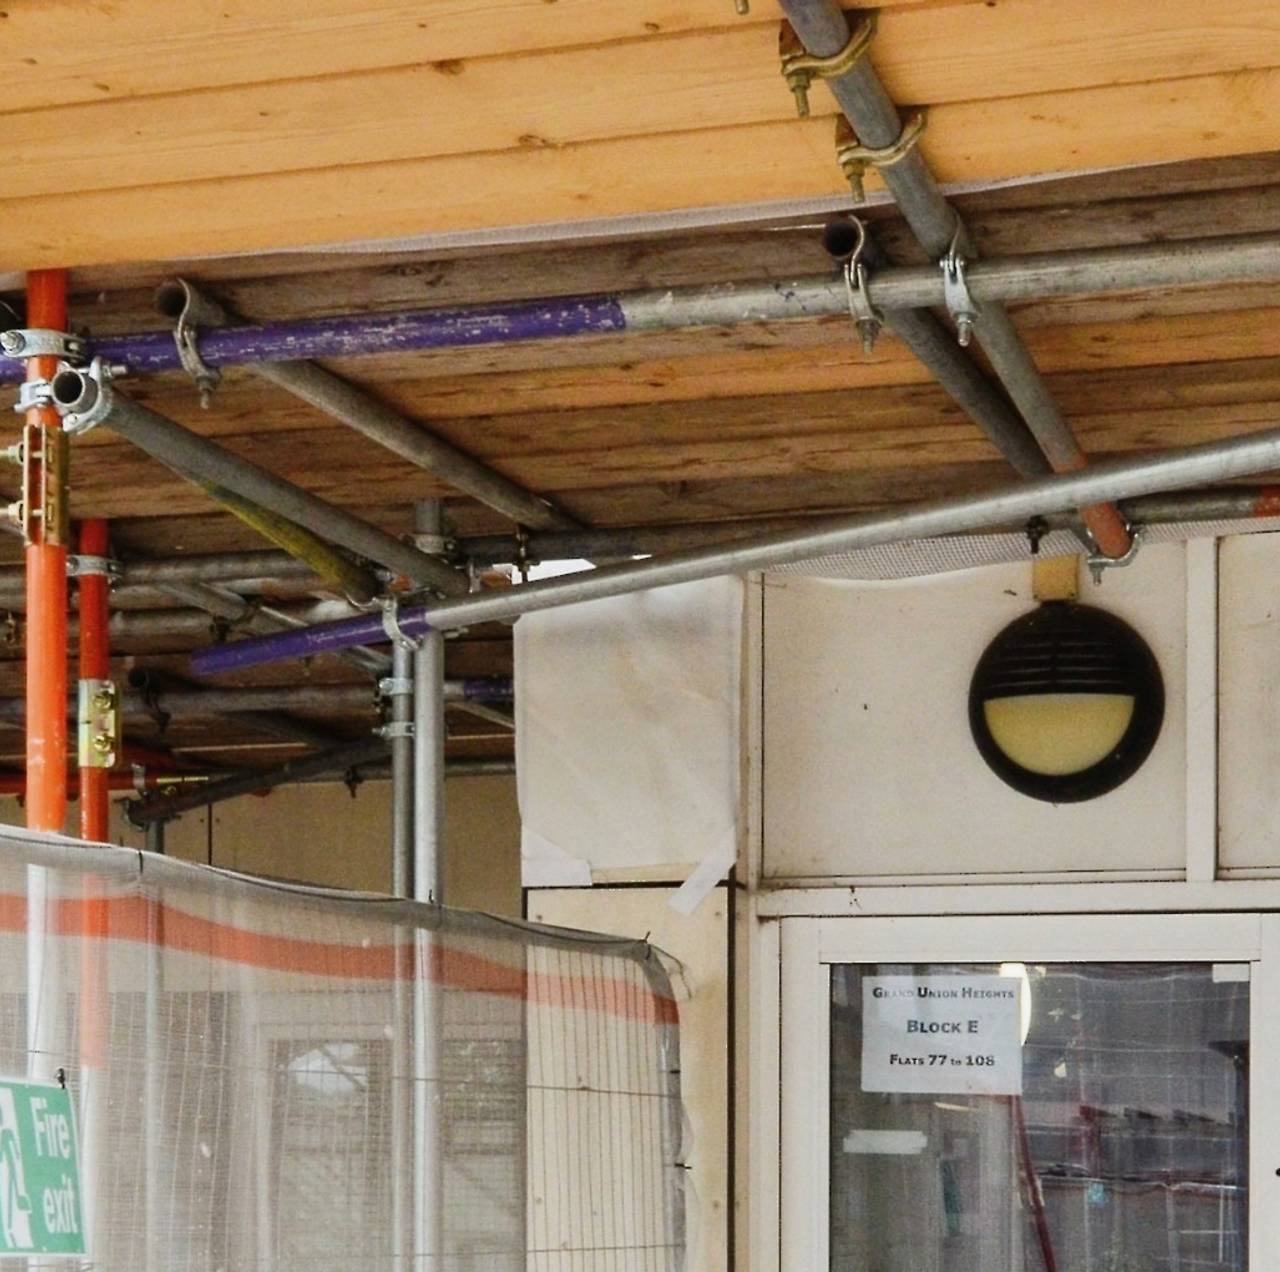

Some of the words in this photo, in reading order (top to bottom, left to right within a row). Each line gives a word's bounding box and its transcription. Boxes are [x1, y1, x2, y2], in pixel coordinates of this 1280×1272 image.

[917, 986, 958, 999] UNION
[962, 987, 1015, 999] HEIGHTS
[906, 1019, 962, 1034] BLOCK
[967, 1019, 979, 1034] E
[889, 1053, 925, 1066] FLATS
[927, 1054, 948, 1067] 77
[950, 1058, 963, 1067] to
[965, 1055, 996, 1067] 108
[29, 1096, 70, 1160] Fire
[42, 1173, 79, 1235] exit
